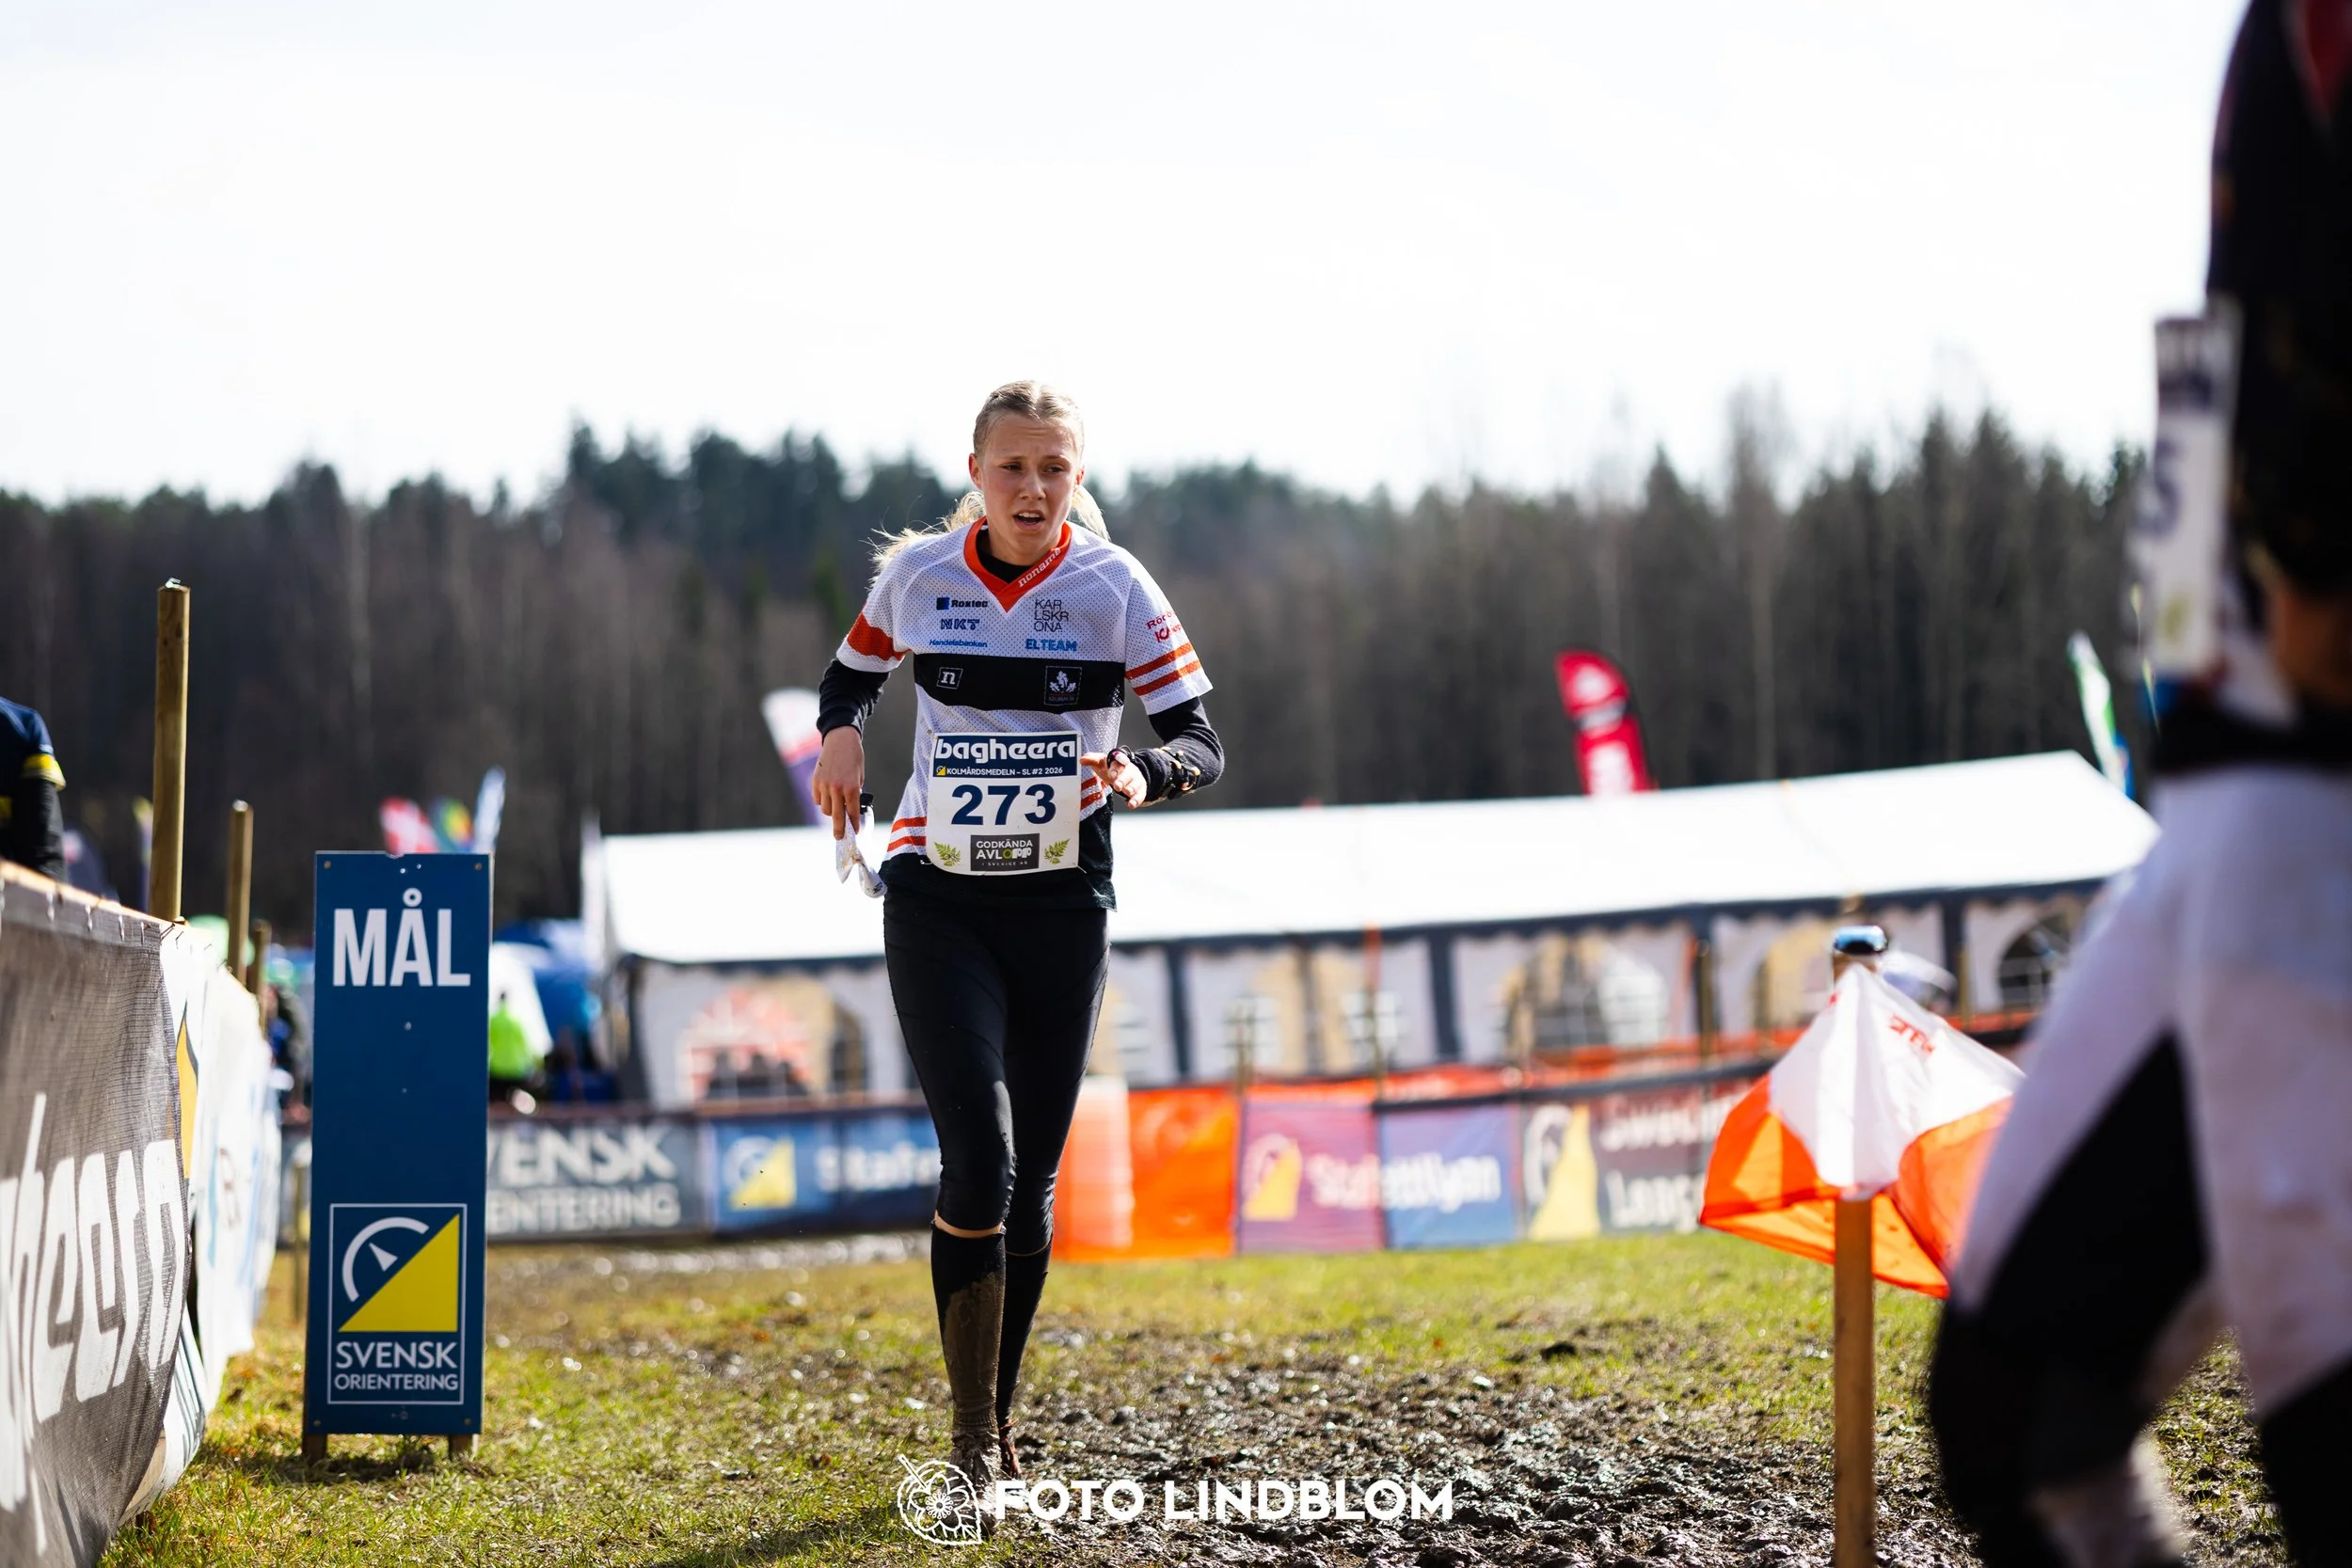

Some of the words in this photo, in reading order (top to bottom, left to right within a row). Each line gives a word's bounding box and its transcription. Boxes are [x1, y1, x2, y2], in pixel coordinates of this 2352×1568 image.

[1018, 547, 1061, 587] noname
[951, 599, 989, 609] Roxtec
[1035, 598, 1062, 611] KAR
[1034, 610, 1070, 622] LSKR
[940, 618, 980, 630] NKT
[1034, 621, 1063, 633] ONA
[929, 639, 988, 648] Handelsbanken
[934, 738, 1076, 764] bagheera
[946, 767, 1016, 776] KOLMÅRDSMEDELN
[1022, 768, 1031, 776] SL
[951, 784, 1057, 826] 273
[976, 838, 1033, 848] GODKÄNDA
[333, 887, 470, 988] MÅL
[336, 1340, 458, 1370] SVENSK
[334, 1372, 459, 1392] ORIENTERING
